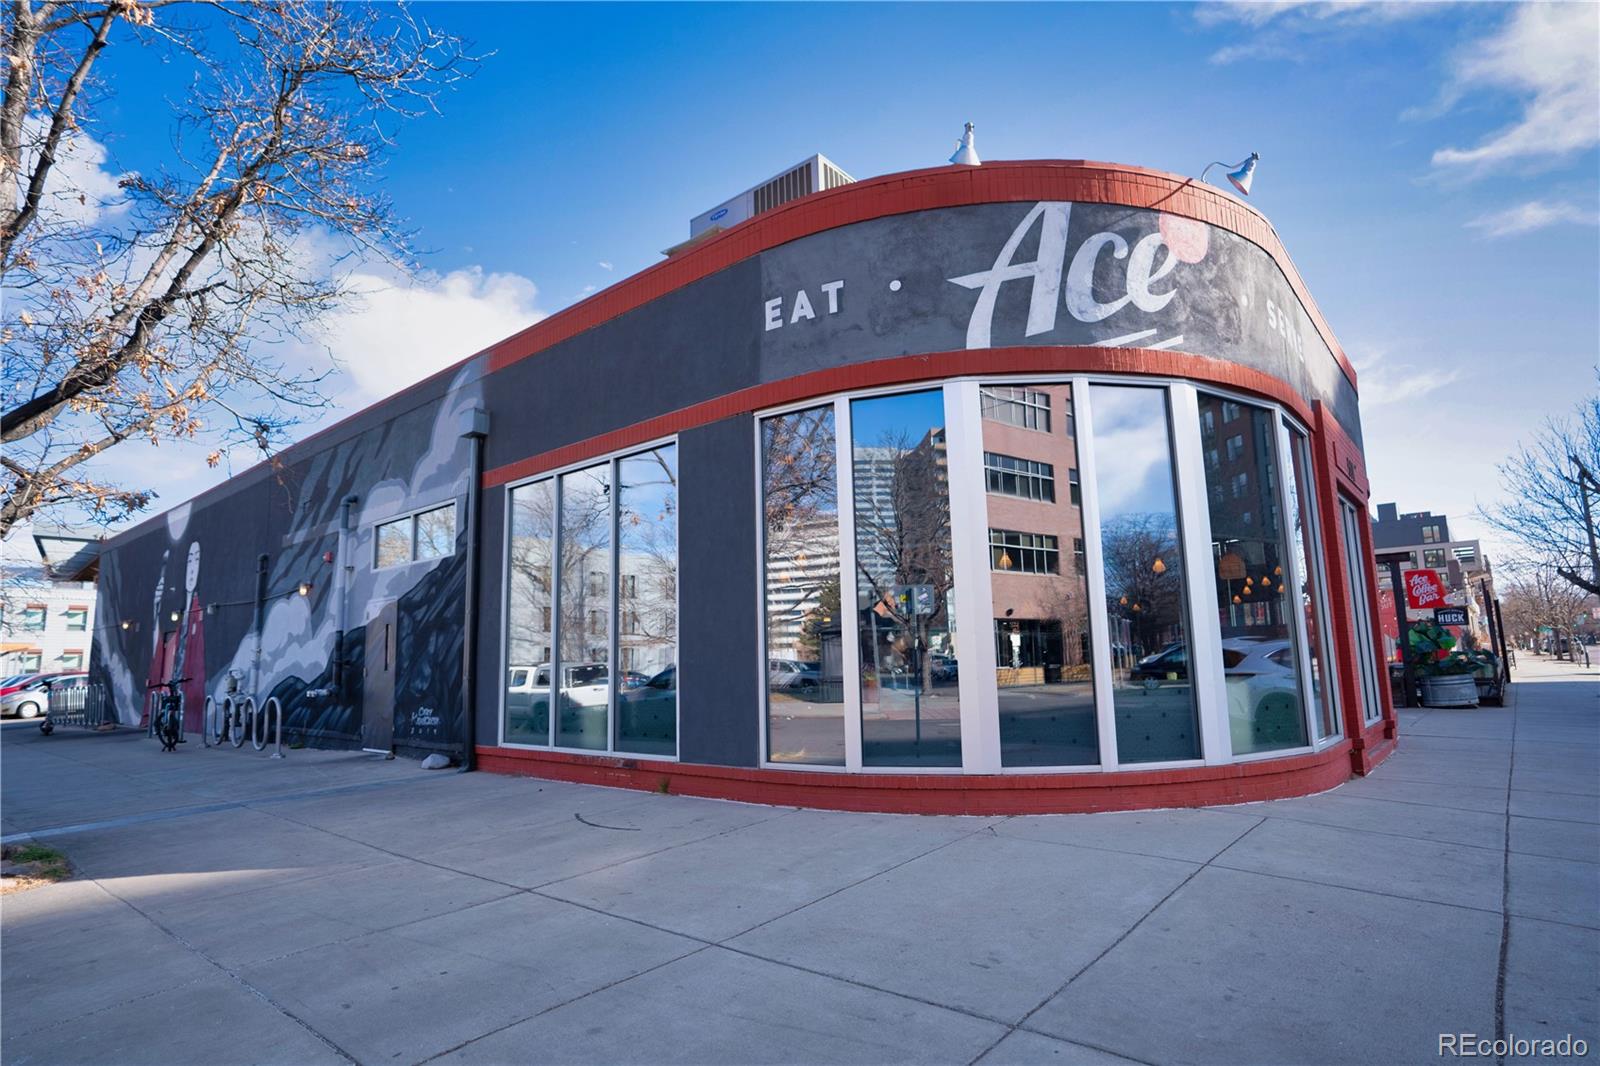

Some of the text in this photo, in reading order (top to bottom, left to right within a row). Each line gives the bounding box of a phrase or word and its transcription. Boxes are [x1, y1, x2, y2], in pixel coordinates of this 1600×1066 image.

[765, 280, 844, 331] EAT
[947, 201, 1178, 349] Ace
[1409, 575, 1428, 587] Ace
[1412, 583, 1438, 598] Coffee
[1419, 593, 1441, 605] Bar
[1438, 613, 1465, 623] HUCK
